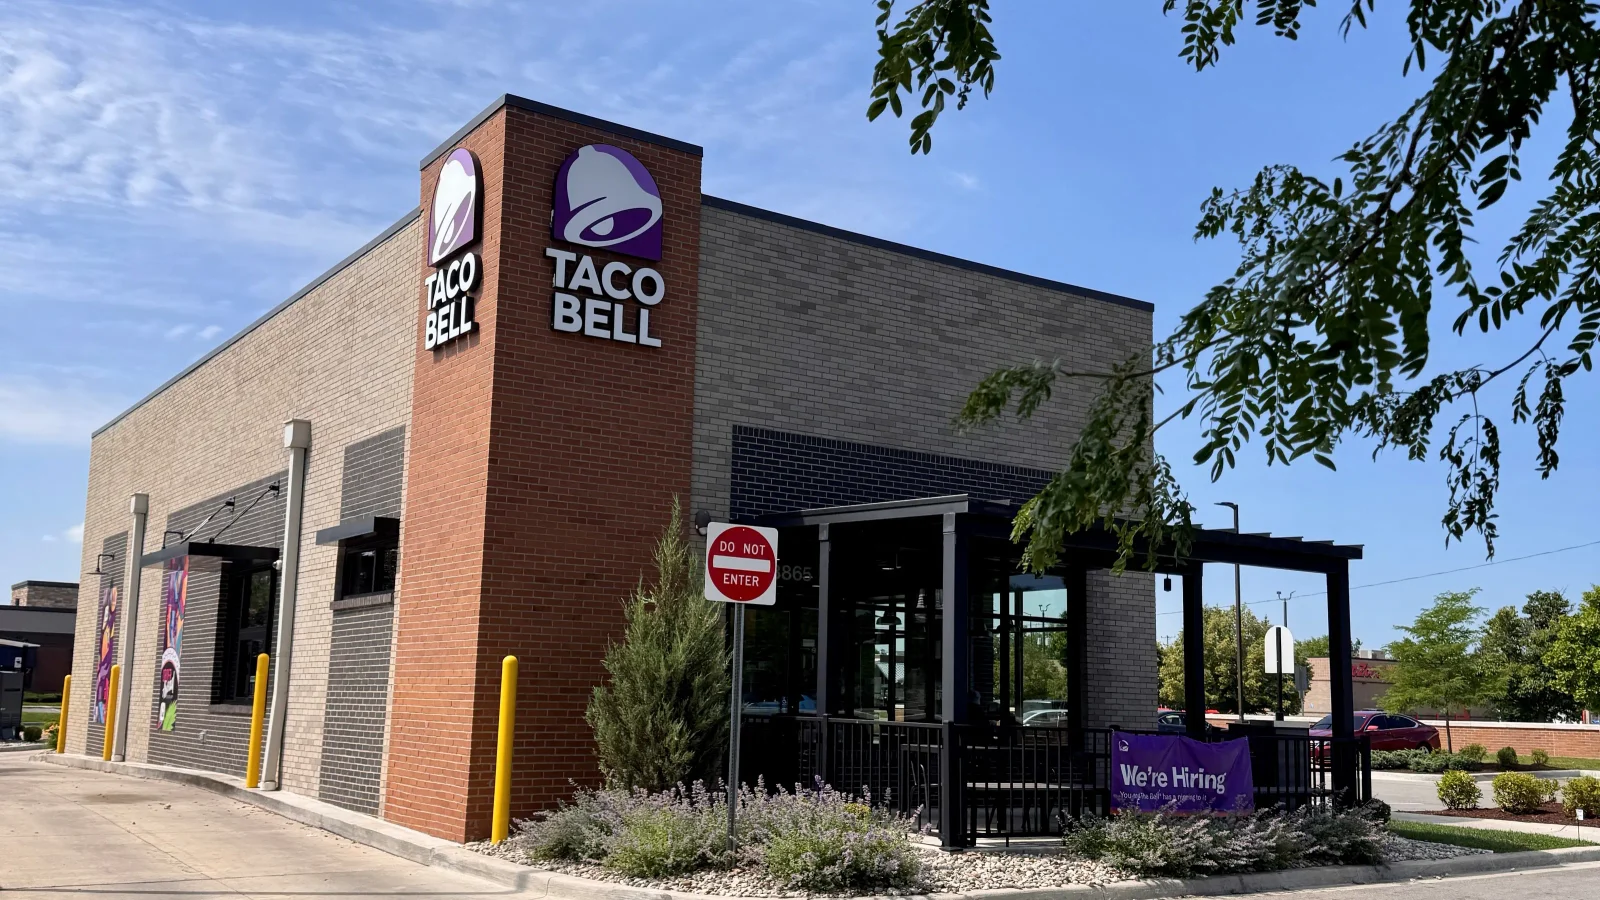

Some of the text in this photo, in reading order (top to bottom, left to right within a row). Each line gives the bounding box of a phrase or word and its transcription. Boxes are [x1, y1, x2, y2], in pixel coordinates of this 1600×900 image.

[424, 252, 476, 311] TACO
[545, 247, 665, 306] TACO
[424, 296, 472, 350] BELL
[553, 292, 662, 348] BELL
[719, 540, 766, 556] DO NOT
[723, 573, 760, 587] ENTER
[1119, 790, 1132, 799] You
[1120, 763, 1227, 794] We're Hiring
